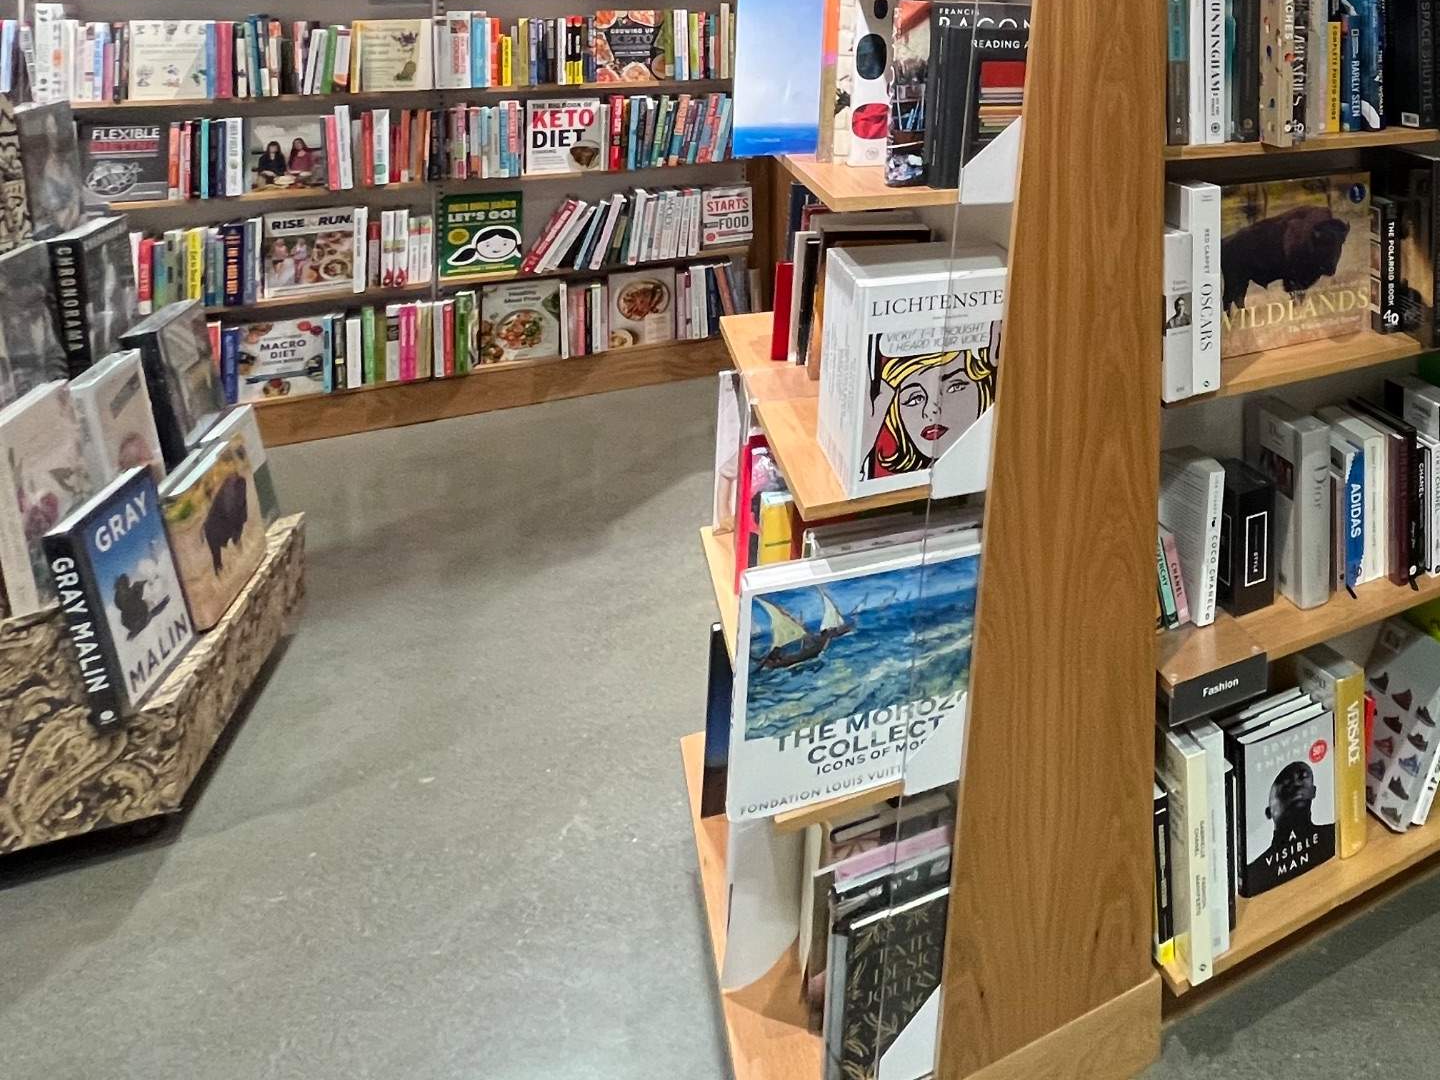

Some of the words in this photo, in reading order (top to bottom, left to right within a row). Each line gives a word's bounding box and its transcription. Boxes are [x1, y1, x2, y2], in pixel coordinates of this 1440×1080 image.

[938, 6, 980, 17] FRANCIS
[1418, 3, 1433, 47] SPACE
[970, 38, 1020, 50] READING
[1350, 59, 1361, 93] RARELY
[531, 109, 595, 129] KETO
[1350, 95, 1361, 118] SEEN
[91, 126, 161, 141] FLEXIBLE
[531, 128, 587, 149] DIET
[447, 210, 485, 223] LET'S
[489, 209, 516, 222] GO!
[706, 197, 750, 213] STARTS
[271, 216, 305, 231] RISE
[317, 214, 353, 227] RUN
[718, 215, 750, 231] FOOD
[1387, 221, 1396, 238] THE
[1387, 239, 1396, 281] POLAROID
[54, 245, 84, 353] CHRONORAMA
[872, 289, 1004, 317] LICHTENSTE
[1387, 282, 1396, 306] BOOK
[1199, 282, 1214, 353] OSCARS
[1221, 286, 1371, 334] WILDLANDS
[259, 339, 307, 353] MACRO
[270, 348, 297, 360] DIET
[1312, 465, 1330, 511] Dior
[93, 490, 148, 554] GRAY
[1349, 482, 1362, 540] ADIDAS
[1209, 534, 1218, 565] COCO
[51, 556, 87, 623] GRAY
[1170, 561, 1184, 598] CHANEL
[1206, 568, 1215, 611] CHANEL
[68, 622, 111, 694] MALIN
[128, 613, 190, 694] MALIN
[1201, 676, 1240, 698] Fashion
[776, 721, 836, 752] THE
[806, 714, 945, 765] COLLECT
[1347, 699, 1361, 768] VERSACE
[816, 753, 866, 776] ICONS
[870, 745, 892, 761] OF
[739, 786, 822, 816] FONDATION
[824, 774, 864, 795] LOUIS
[1265, 832, 1320, 868] VISIBLE
[1288, 829, 1297, 842] A
[1276, 852, 1310, 877] MAN
